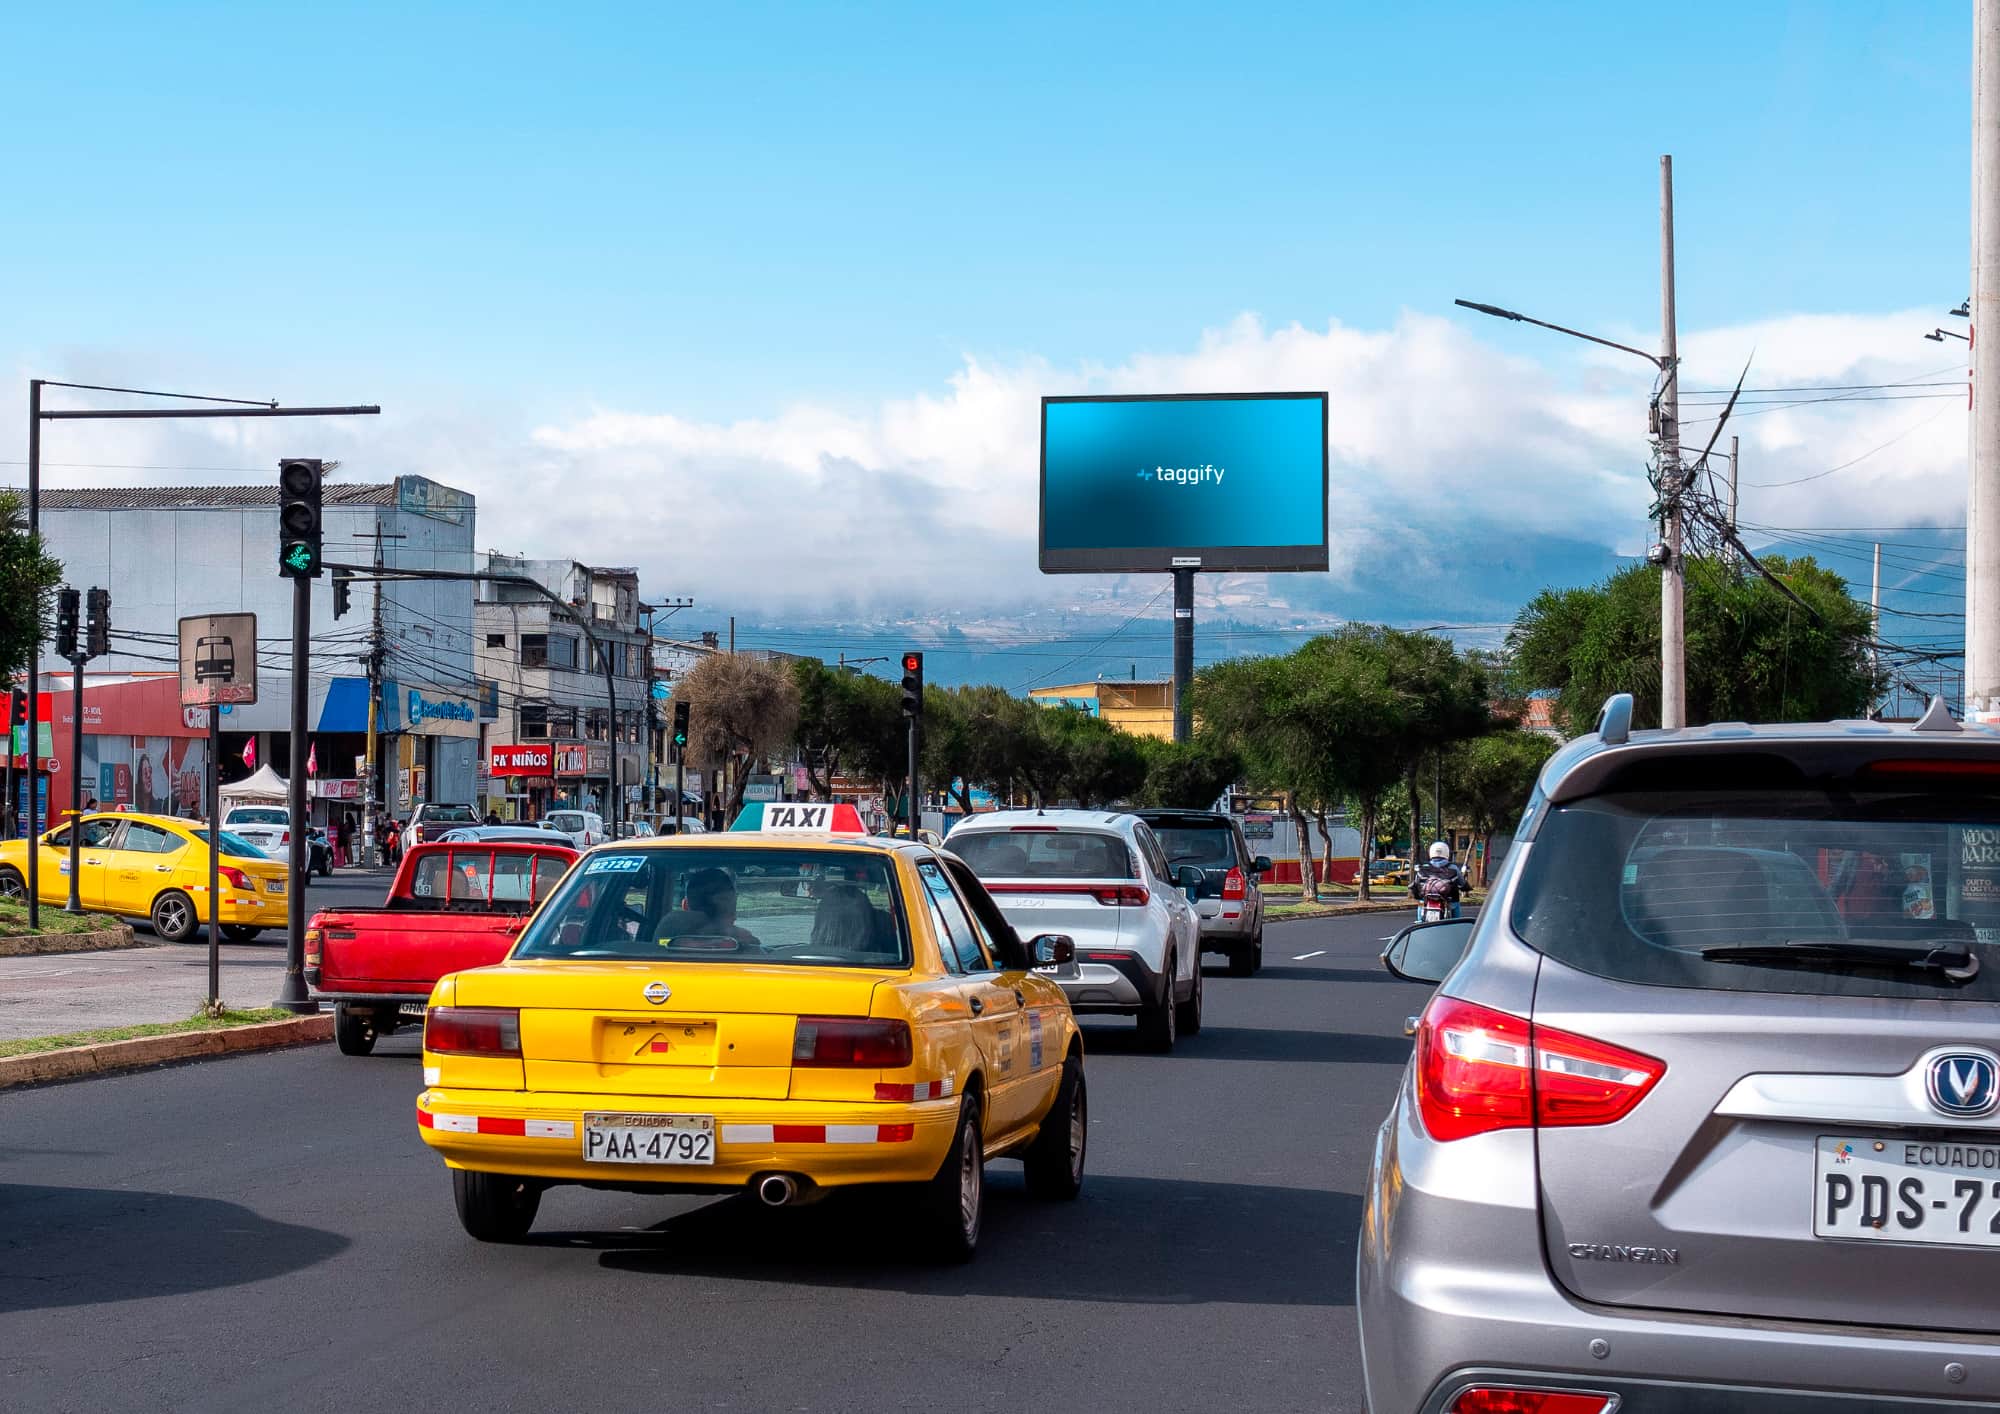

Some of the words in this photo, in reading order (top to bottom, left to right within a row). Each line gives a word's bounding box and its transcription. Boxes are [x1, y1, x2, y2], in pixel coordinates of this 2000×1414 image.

[1156, 465, 1225, 484] taggify
[184, 707, 210, 728] Clar
[512, 751, 548, 767] NIÑOS
[770, 807, 827, 827] TAXI
[624, 1117, 674, 1128] ECUADOR
[588, 1131, 711, 1160] PAA-4792
[1904, 1144, 2000, 1168] ECUADO
[1568, 1243, 1680, 1264] CHANGAN
